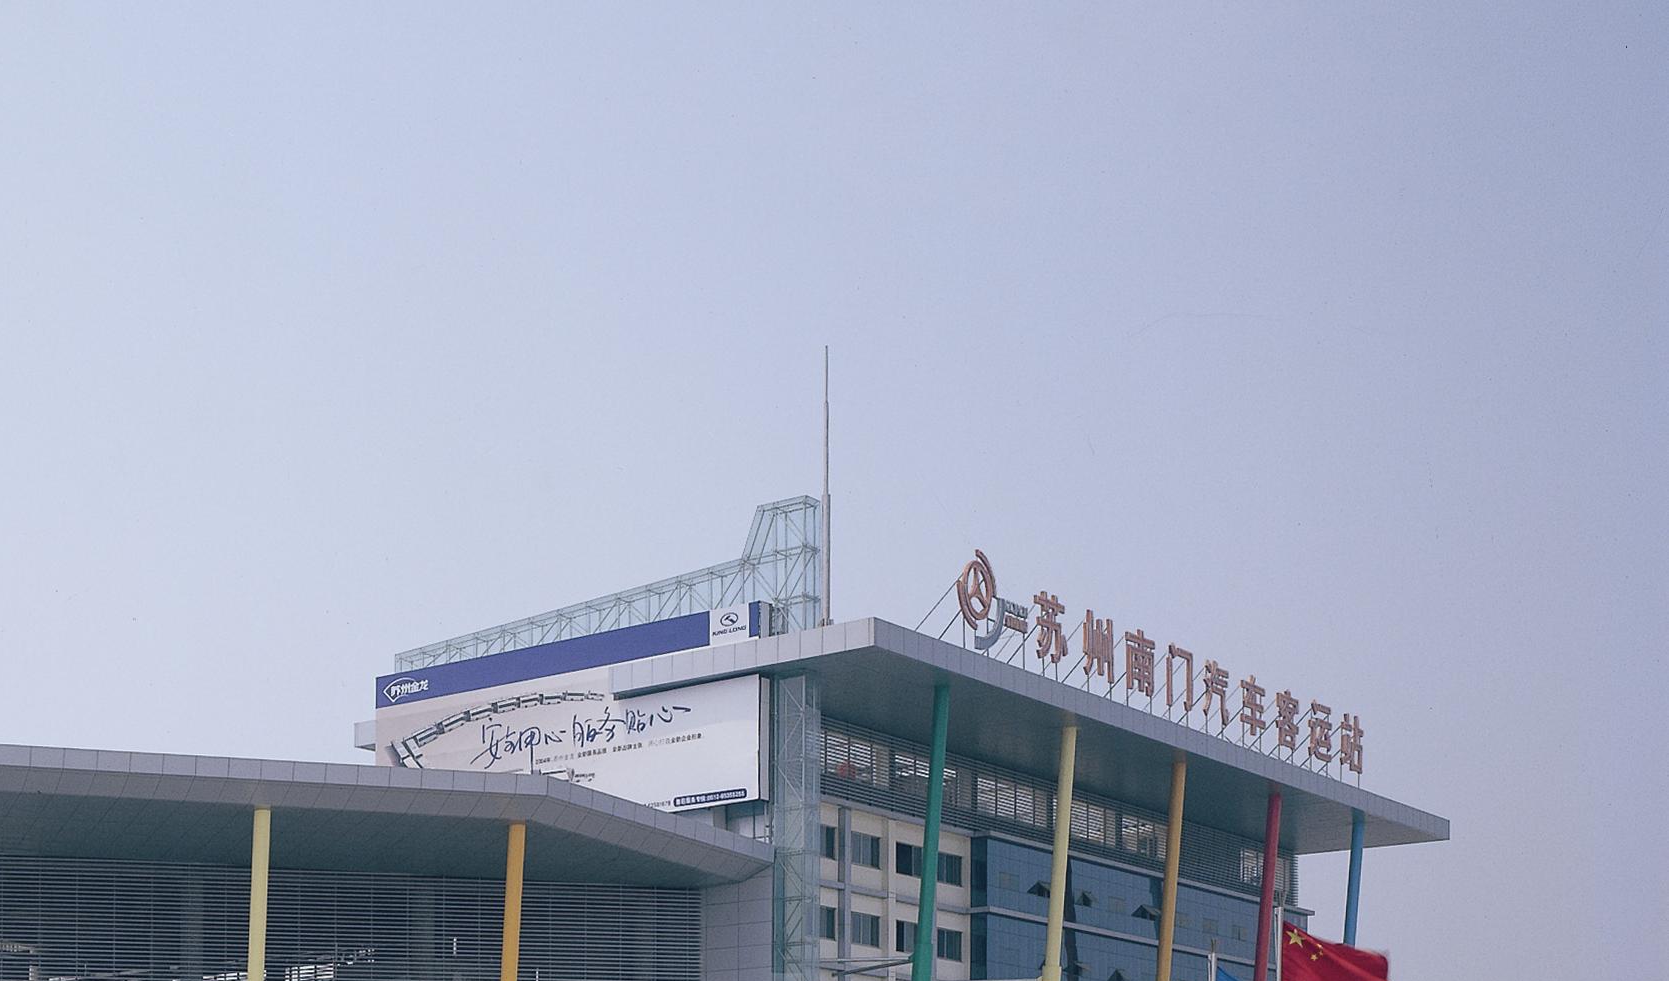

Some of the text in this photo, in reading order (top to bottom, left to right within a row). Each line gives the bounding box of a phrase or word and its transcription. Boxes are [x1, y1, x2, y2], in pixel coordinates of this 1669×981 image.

[1033, 590, 1364, 775] 苏州南门汽车客运站
